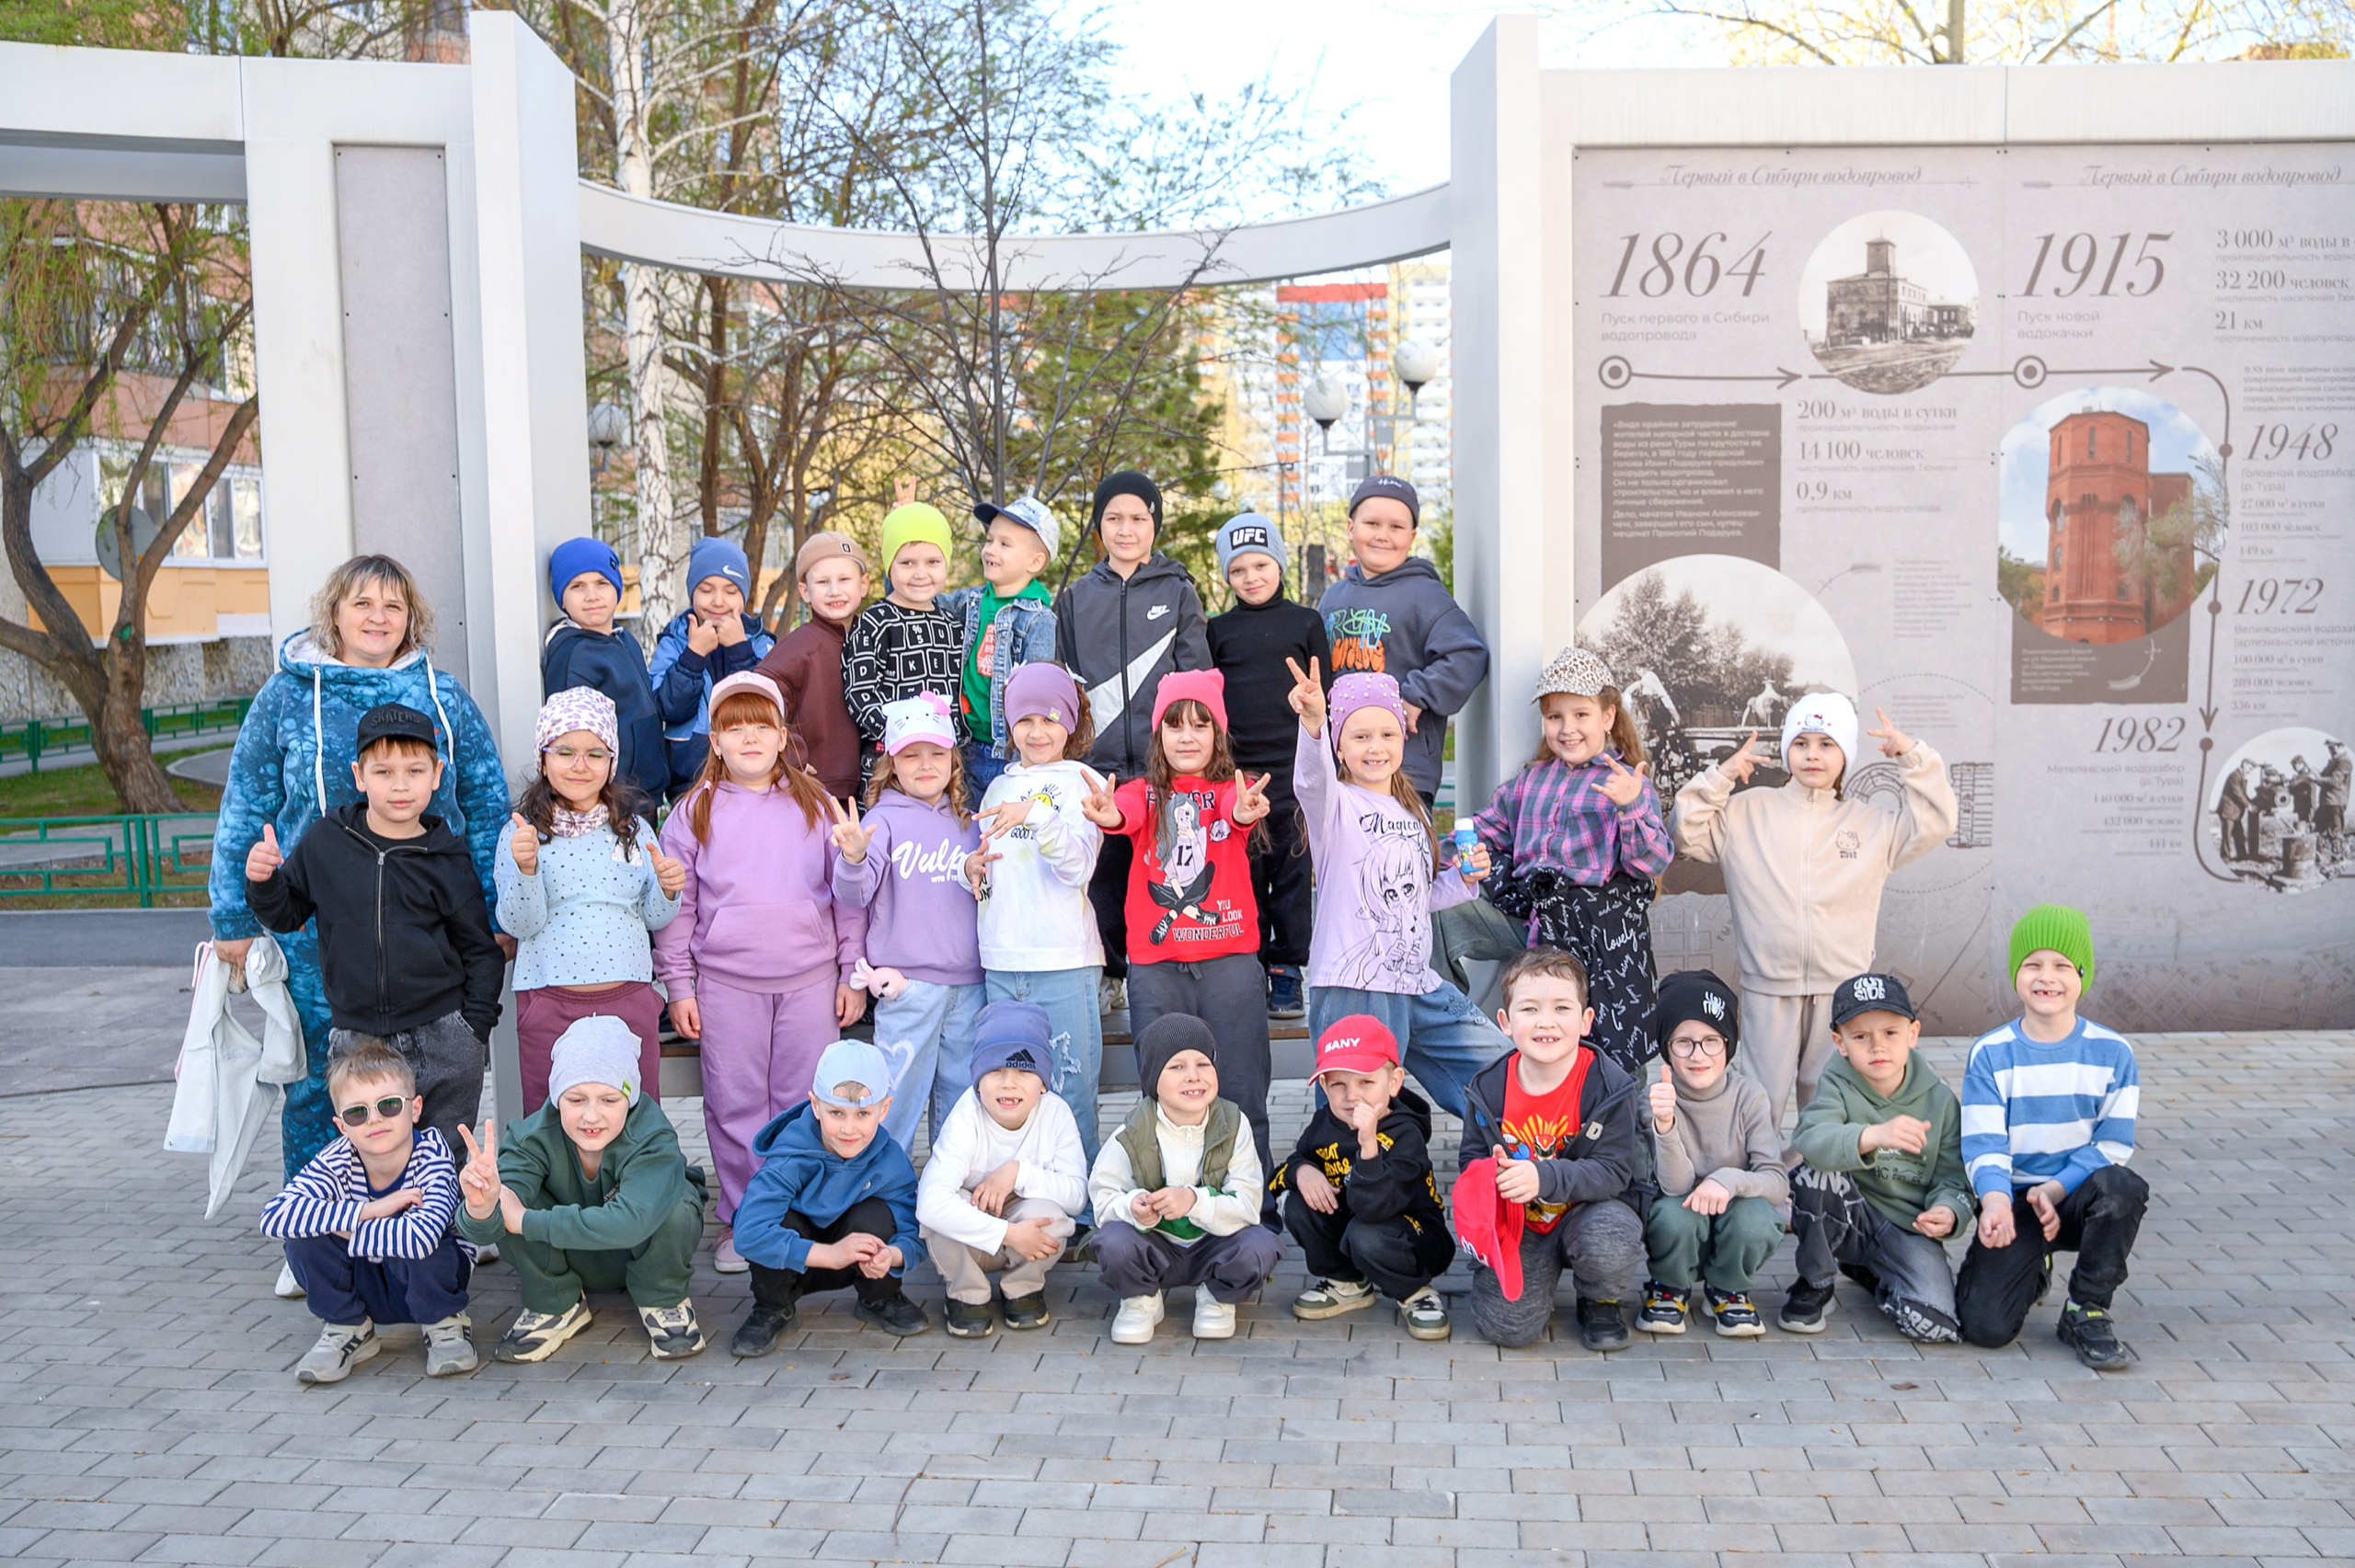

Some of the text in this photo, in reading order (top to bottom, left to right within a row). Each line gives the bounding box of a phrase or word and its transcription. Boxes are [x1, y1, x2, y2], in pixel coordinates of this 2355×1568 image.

[1666, 165, 1922, 189] Первый в Сибири водопровод
[2085, 166, 2342, 189] Первый в Сибири водопровод
[2217, 229, 2228, 248] 3
[2234, 229, 2273, 248] 000
[2300, 236, 2338, 250] воды
[2342, 237, 2349, 248] в
[1599, 230, 1773, 298] 1864
[2014, 231, 2174, 297] 1915
[2216, 270, 2349, 290] 32 200 человек
[1602, 312, 1770, 327] Пуск первого в Сибири
[2018, 310, 2099, 325] Пуск новой
[2215, 311, 2262, 329] 21 км
[1602, 329, 1696, 343] водопровода
[2018, 328, 2093, 341] водокачки
[1798, 401, 1835, 419] 200
[1862, 407, 1899, 421] воды
[1904, 408, 1912, 418] в
[1916, 407, 1957, 421] сутки
[1797, 423, 1956, 433] производительность водокачки
[1826, 441, 1861, 460] 100
[1866, 448, 1924, 460] человек
[2242, 422, 2338, 461] 1948
[2241, 468, 2293, 478] Головной
[1797, 482, 1852, 500] 0,9 км
[1233, 529, 1266, 546] UFC
[2233, 578, 2324, 614] 1972
[371, 708, 420, 727] SKATERS
[2089, 716, 2186, 753] 1982
[2047, 763, 2185, 774] Метелевский водозабор
[2156, 776, 2184, 787] Тура)
[891, 838, 964, 882] Vulp
[1177, 845, 1193, 866] 17
[1216, 899, 1231, 910] YOU
[1222, 910, 1243, 923] LOOK
[1172, 924, 1245, 942] WONDERFUL
[1325, 1037, 1361, 1053] SANY
[1005, 1059, 1036, 1070] adidas
